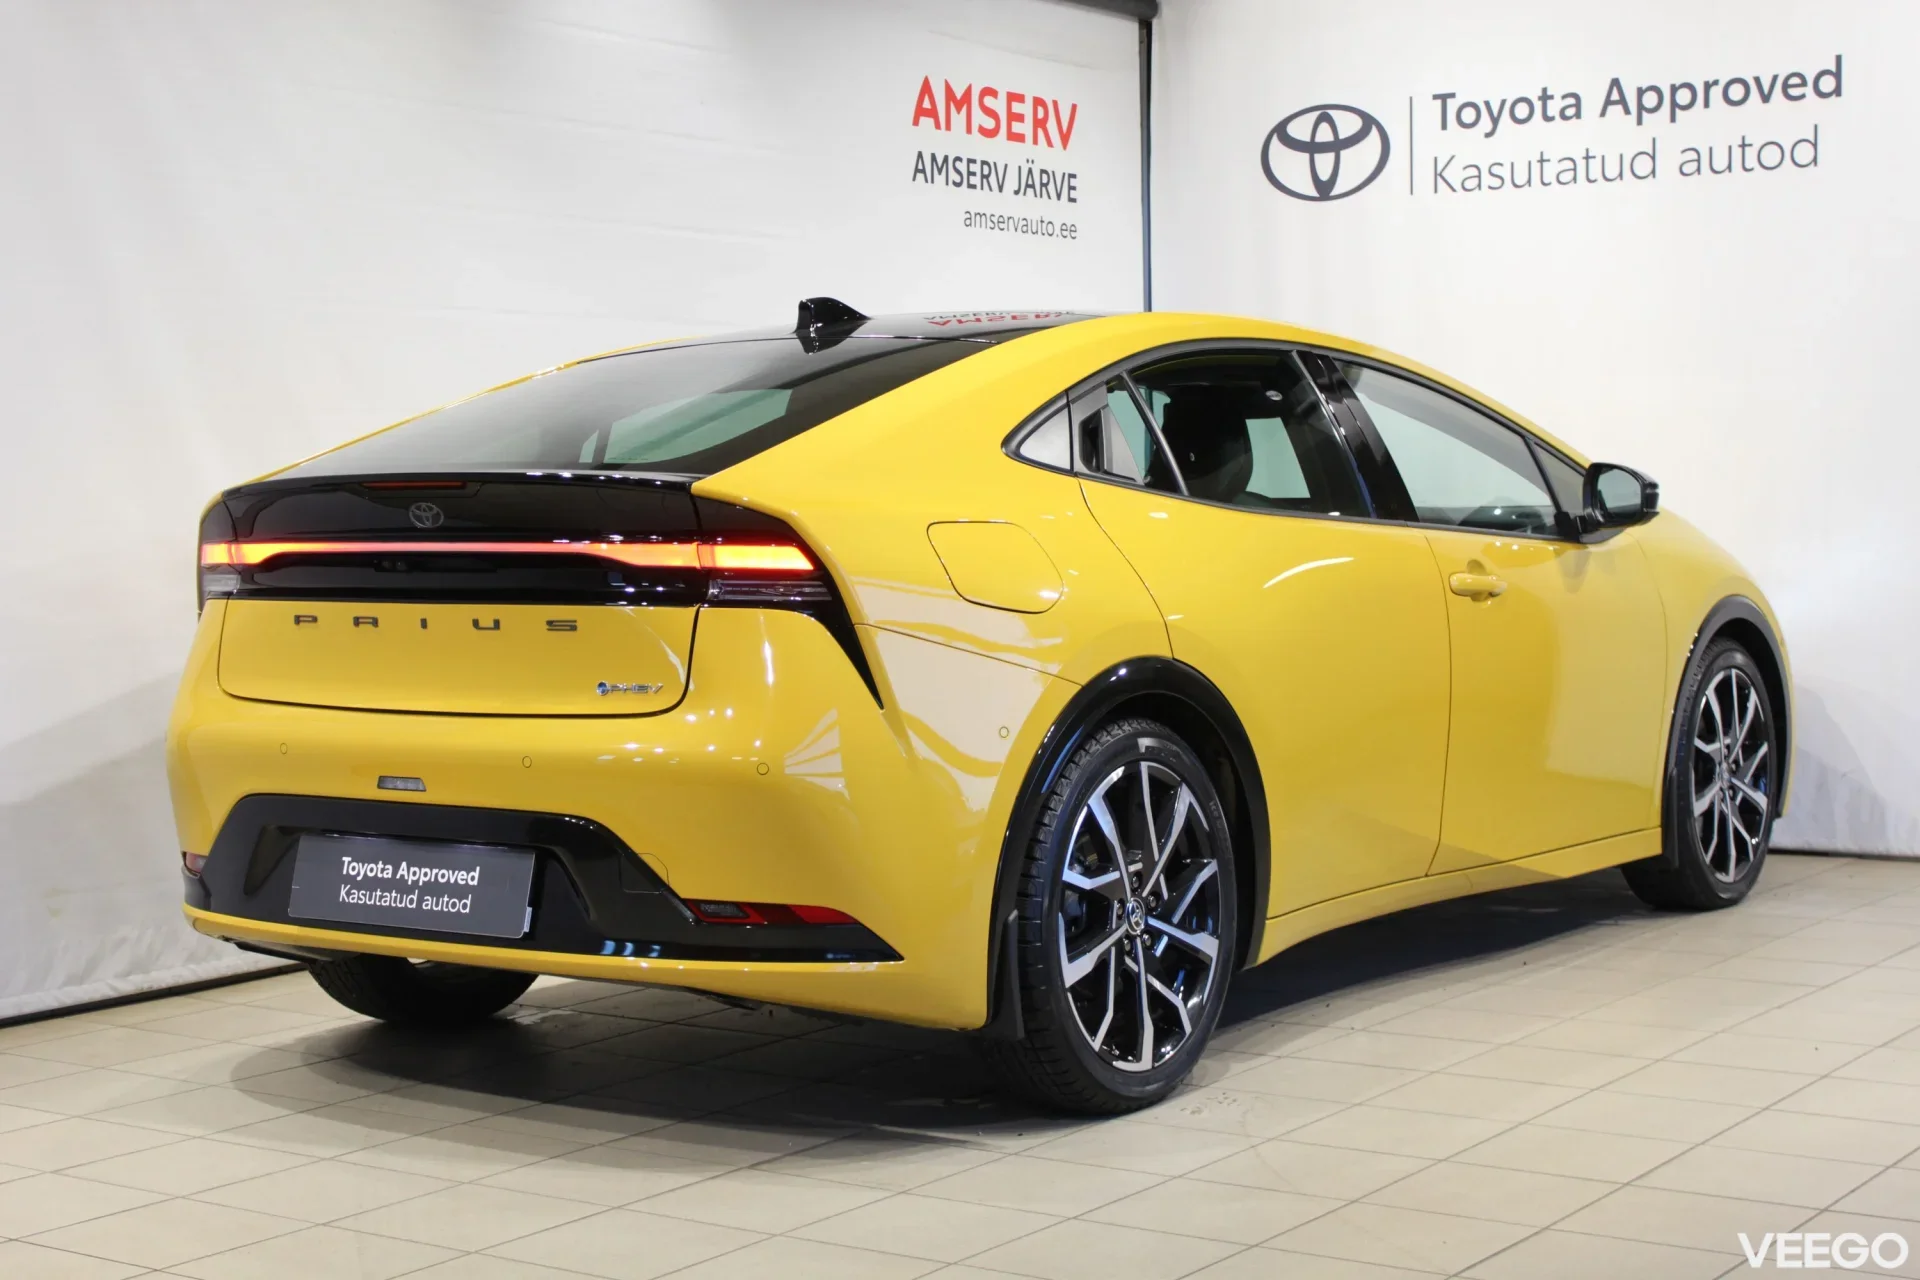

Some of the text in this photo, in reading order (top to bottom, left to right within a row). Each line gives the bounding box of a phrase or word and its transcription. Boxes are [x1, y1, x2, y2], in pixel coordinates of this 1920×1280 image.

[1432, 54, 1843, 138] Toyota Approved
[912, 75, 1077, 151] AMSERV
[1433, 124, 1819, 194] Kasutatud autod
[912, 151, 1077, 203] AMSERV JÄRVE
[964, 210, 1077, 239] amservauto.ee
[294, 614, 578, 632] PRIUS
[609, 683, 663, 695] PHEV
[341, 856, 480, 886] Toyota Approved
[339, 884, 471, 914] Kasutatud autod
